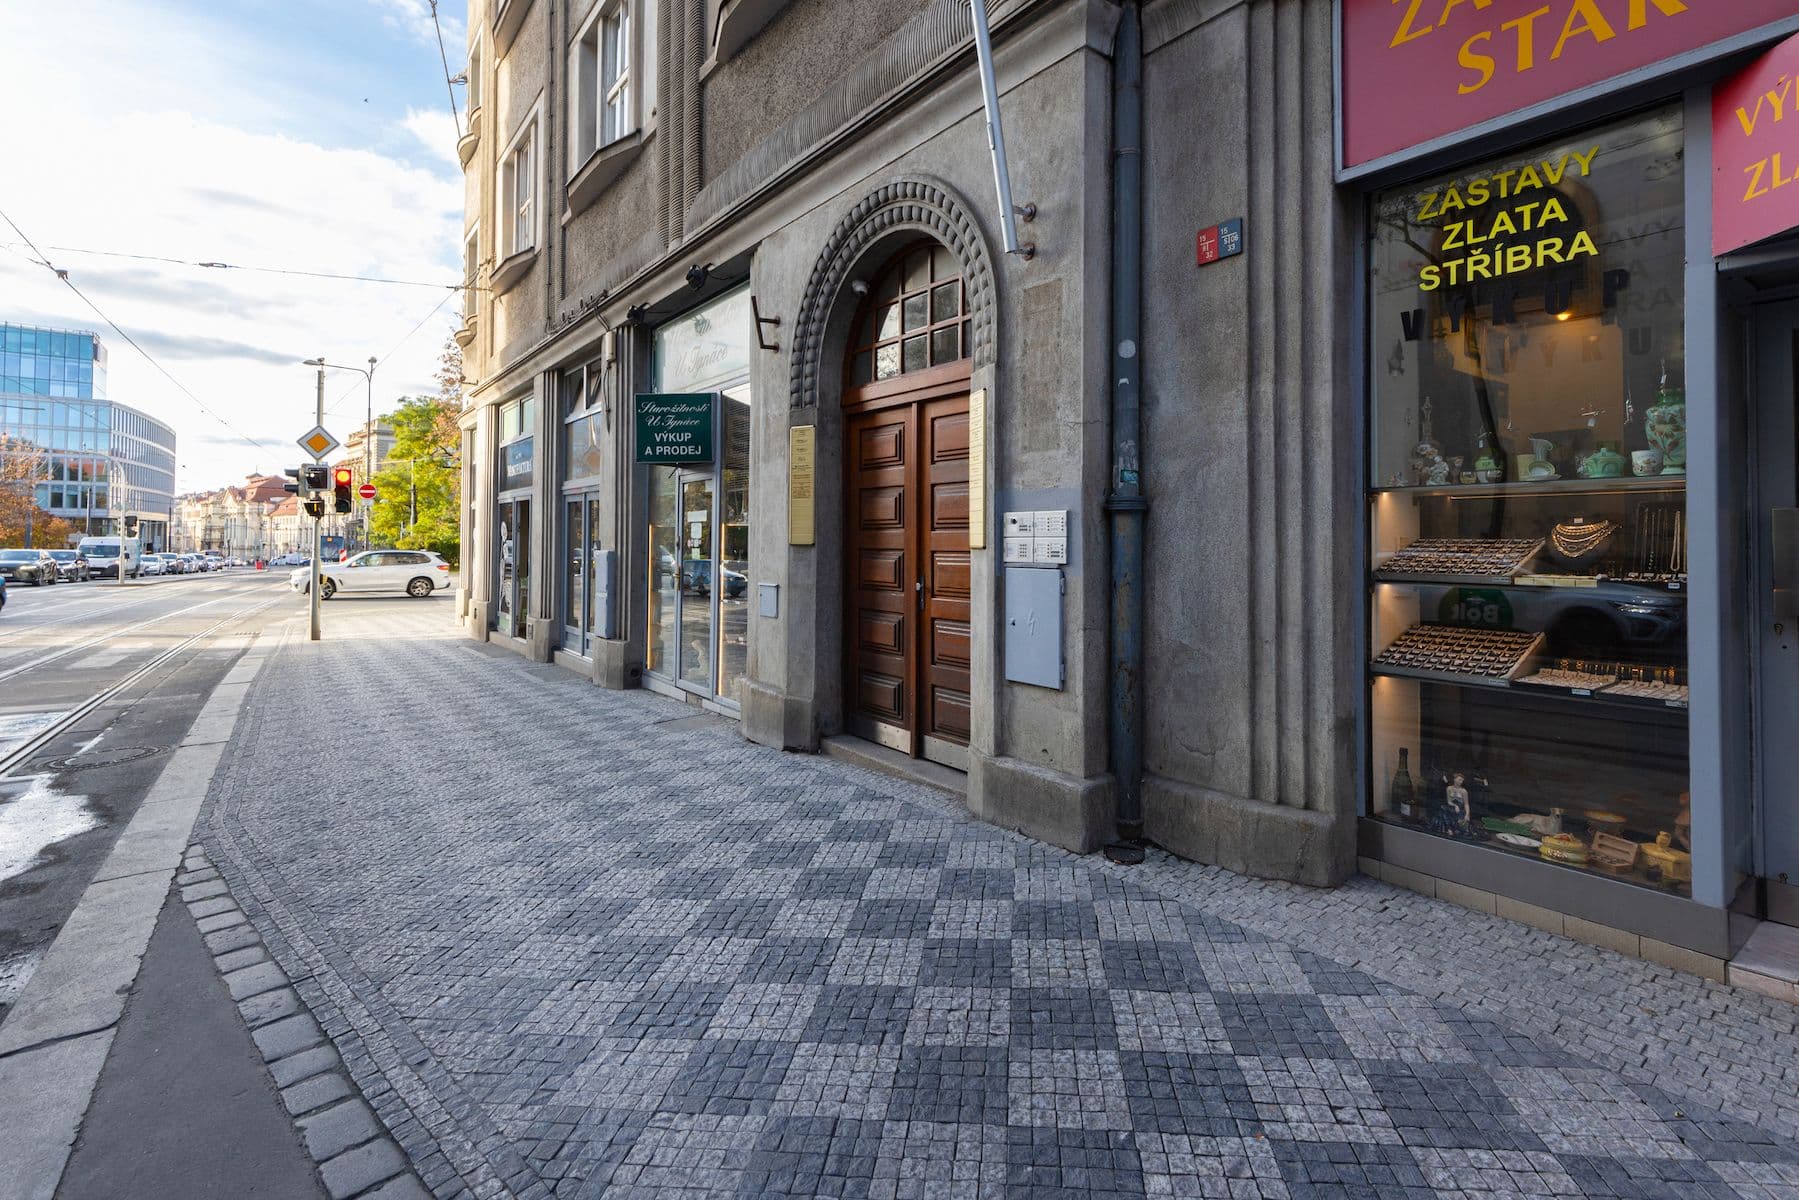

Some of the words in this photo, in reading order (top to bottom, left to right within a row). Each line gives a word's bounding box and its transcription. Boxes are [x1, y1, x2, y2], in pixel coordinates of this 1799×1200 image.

[1736, 72, 1799, 136] VÝ
[1416, 146, 1599, 221] ZÁSTAVY
[1743, 152, 1799, 202] ZL
[1441, 198, 1568, 251] ZLATA
[1419, 230, 1599, 291] STŘÍBRA
[645, 415, 661, 427] U
[654, 430, 692, 443] VÝKUP
[644, 446, 653, 456] A
[655, 445, 702, 456] PRODEJ
